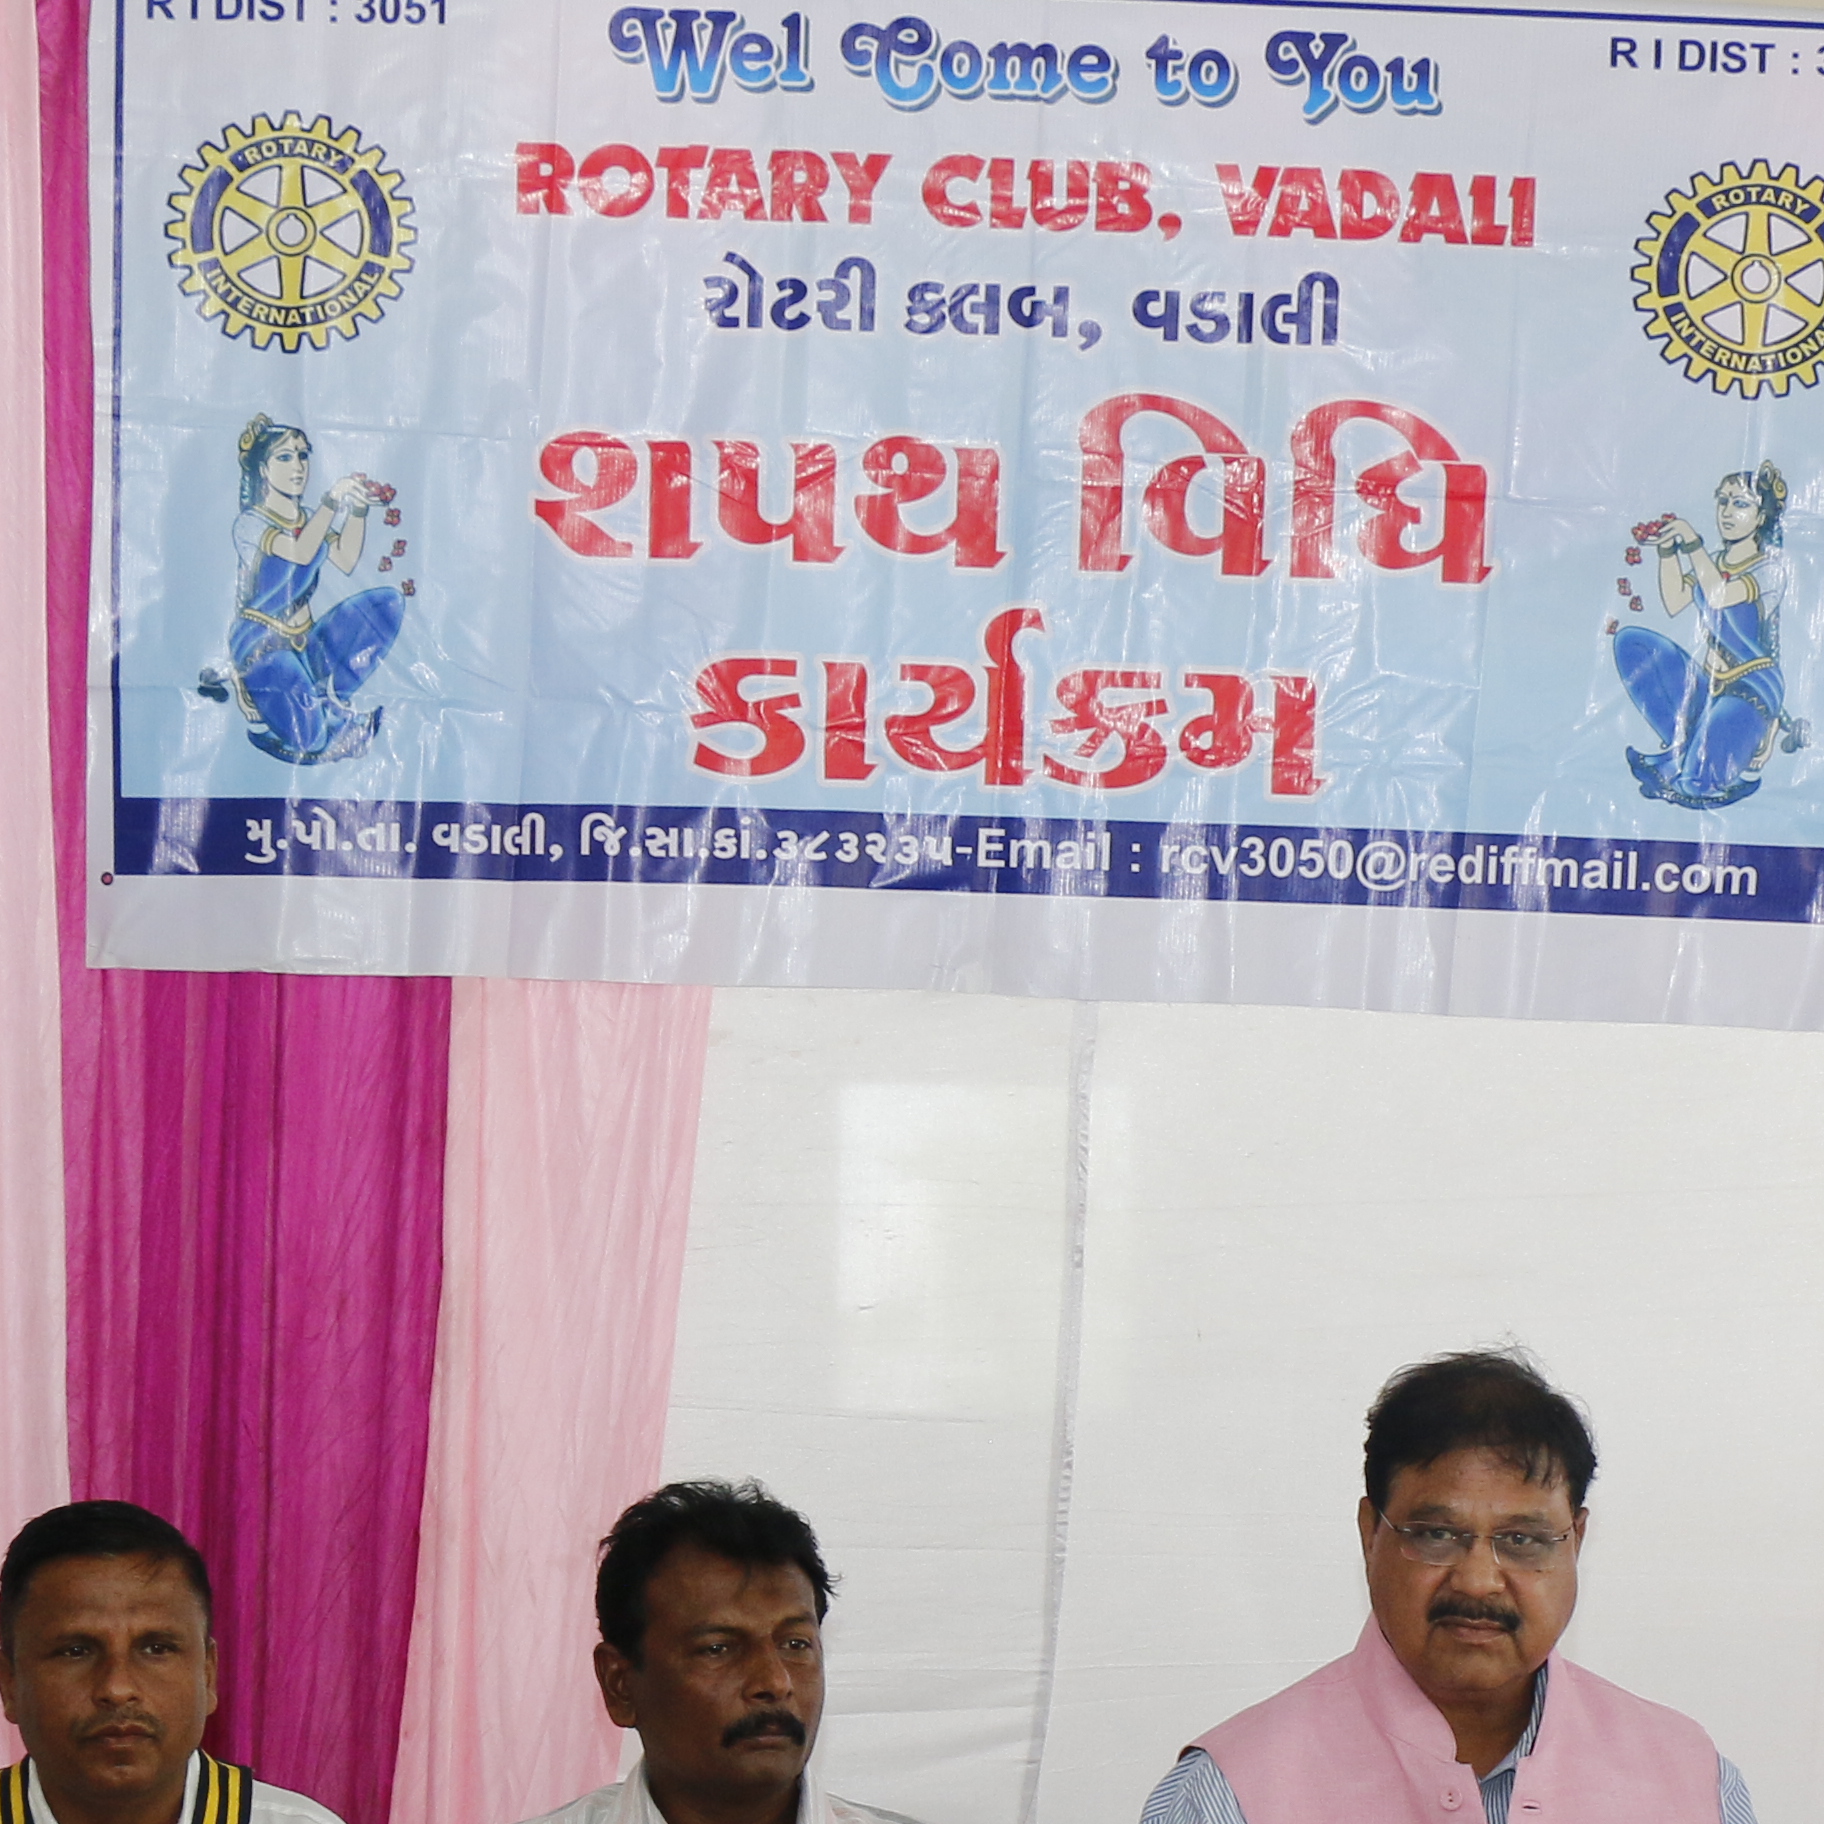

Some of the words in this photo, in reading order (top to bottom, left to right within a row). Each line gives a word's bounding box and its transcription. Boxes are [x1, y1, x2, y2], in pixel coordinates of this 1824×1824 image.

[146, 0, 175, 20] R
[215, 0, 304, 22] DIST
[354, 0, 447, 25] 3051
[608, 6, 814, 103] Wel
[840, 15, 1118, 112] Come
[1145, 33, 1239, 107] to
[1265, 28, 1442, 124] You
[1610, 37, 1638, 68] R
[1654, 39, 1662, 69] I
[1678, 41, 1775, 74] DIST
[243, 138, 345, 167] ROTARY
[516, 142, 893, 225] ROTARY
[922, 153, 1182, 241] CLUB,
[1214, 162, 1537, 248] VADALI
[1711, 186, 1810, 215] ROTARY
[205, 265, 381, 326] INTERNATIONAL
[703, 251, 876, 332] રોટરી
[1132, 271, 1340, 346] વડાલી
[534, 430, 1010, 570] શપથ
[1078, 392, 1494, 584] વિધિ
[432, 811, 564, 862] વડાલી,
[1160, 835, 1760, 899] rcv3050@rediffmail.com
